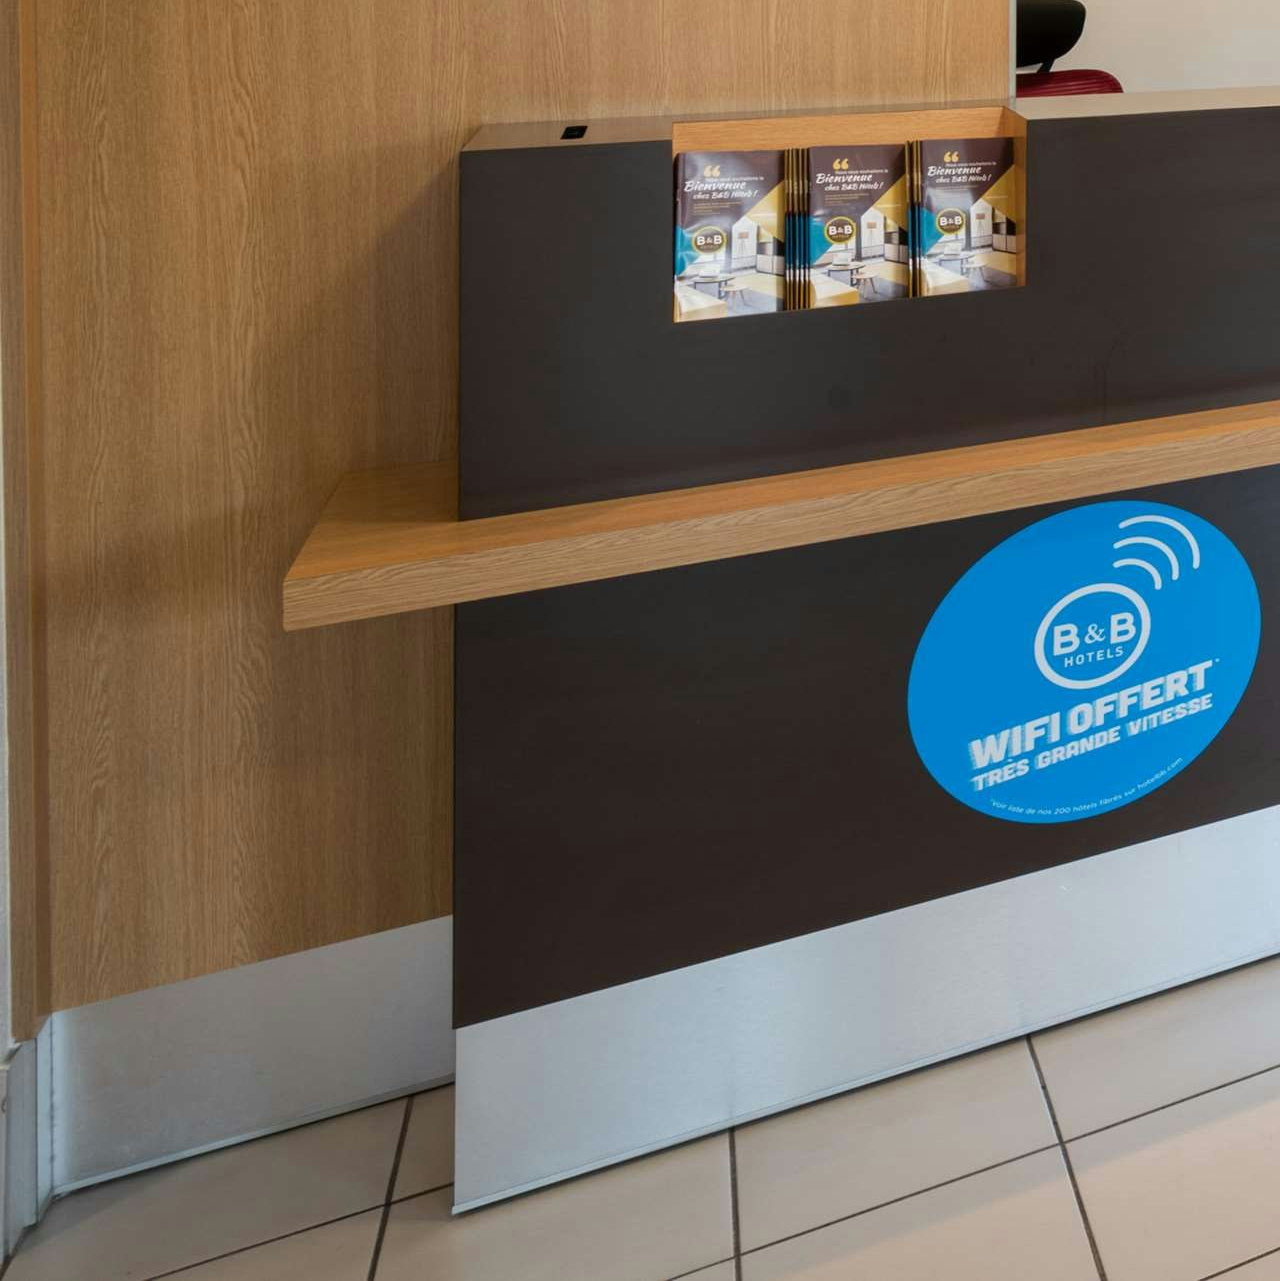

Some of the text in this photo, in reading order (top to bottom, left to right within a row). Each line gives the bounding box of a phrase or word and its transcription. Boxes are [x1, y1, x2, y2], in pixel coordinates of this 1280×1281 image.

[927, 165, 982, 177] Bienvenue
[815, 173, 873, 184] Bienvenue
[684, 180, 746, 192] Bienvenue
[939, 216, 962, 226] B&B
[828, 225, 852, 236] B&B
[696, 235, 722, 245] B&B
[1052, 612, 1136, 656] B&B
[1064, 646, 1124, 668] HOTELS
[968, 712, 1060, 770] WIFI
[970, 693, 1213, 792] TRÈS GRANDE VITESSE
